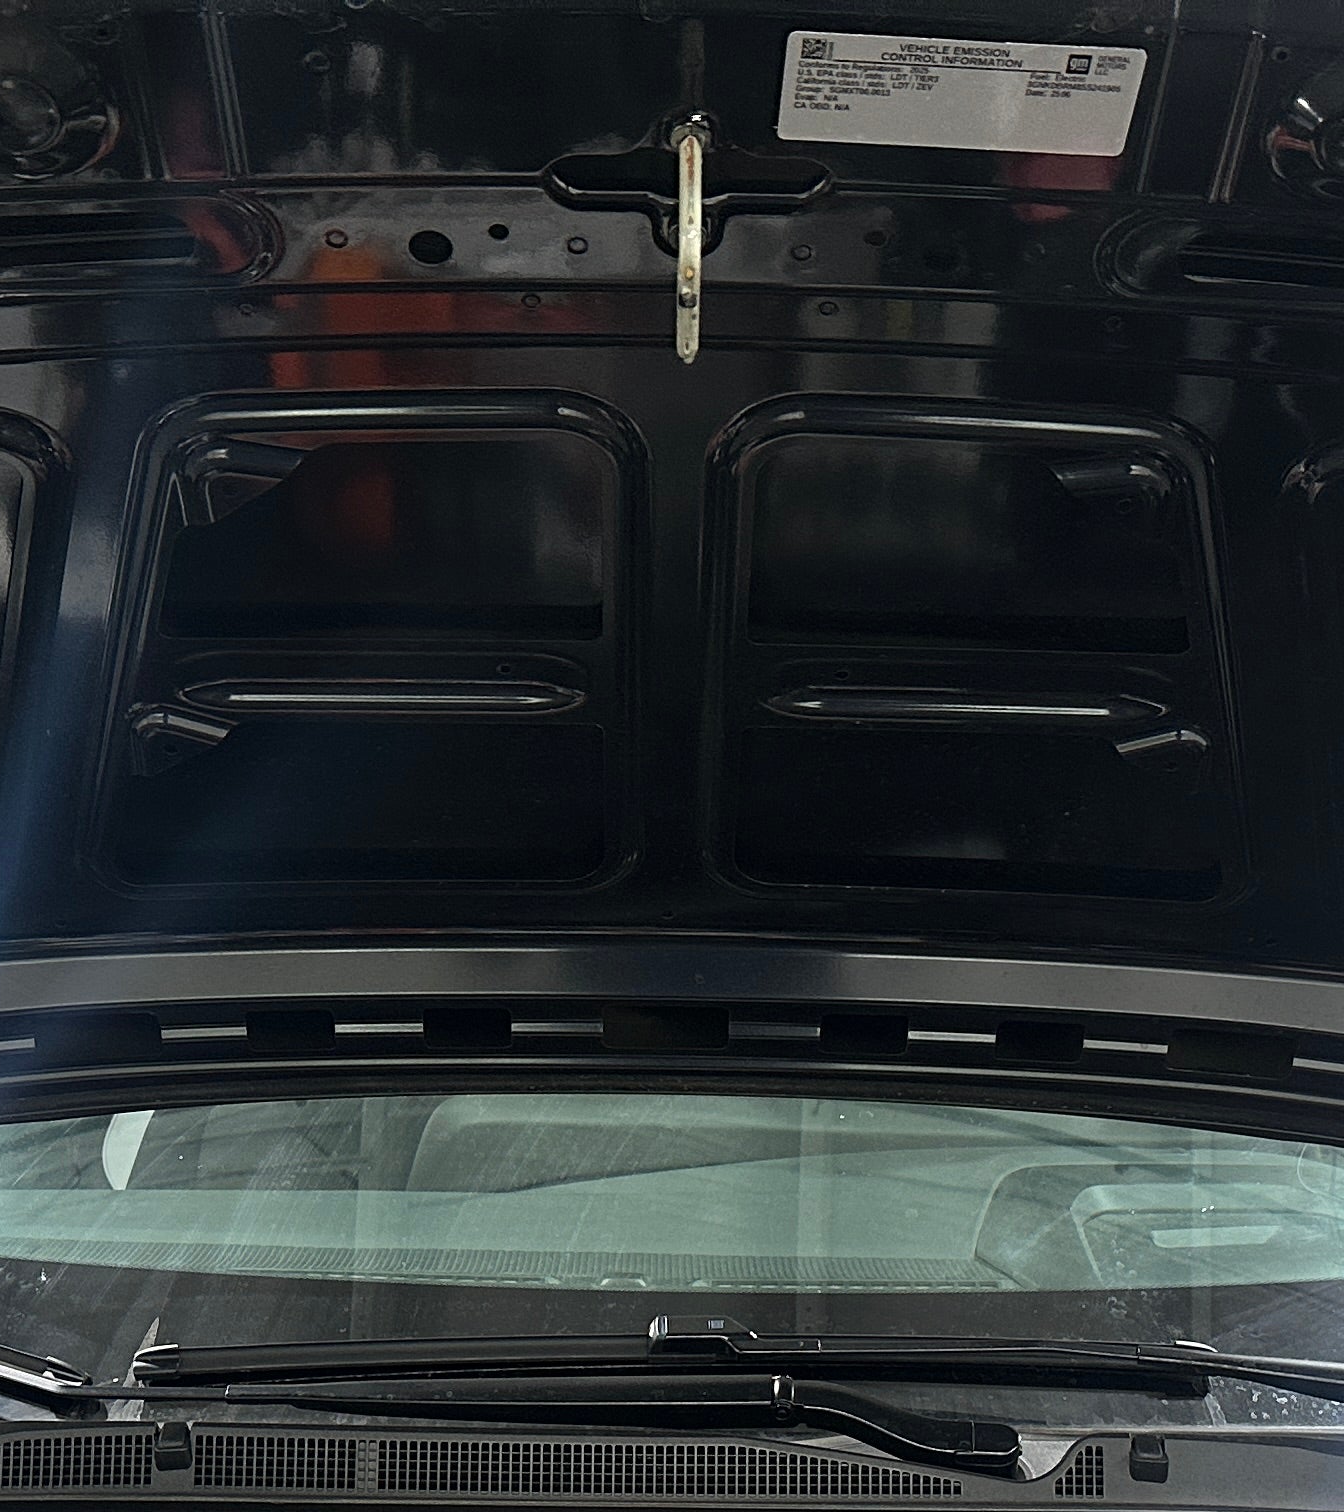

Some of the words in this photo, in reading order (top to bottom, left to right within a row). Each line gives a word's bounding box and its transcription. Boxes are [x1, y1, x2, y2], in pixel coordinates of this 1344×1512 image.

[900, 44, 950, 54] VEHICLE
[954, 47, 1010, 57] EMISSION
[881, 52, 938, 64] CONTROL
[941, 56, 1023, 68] INFORMATION
[1071, 58, 1088, 71] gm
[916, 83, 933, 91] ZEV
